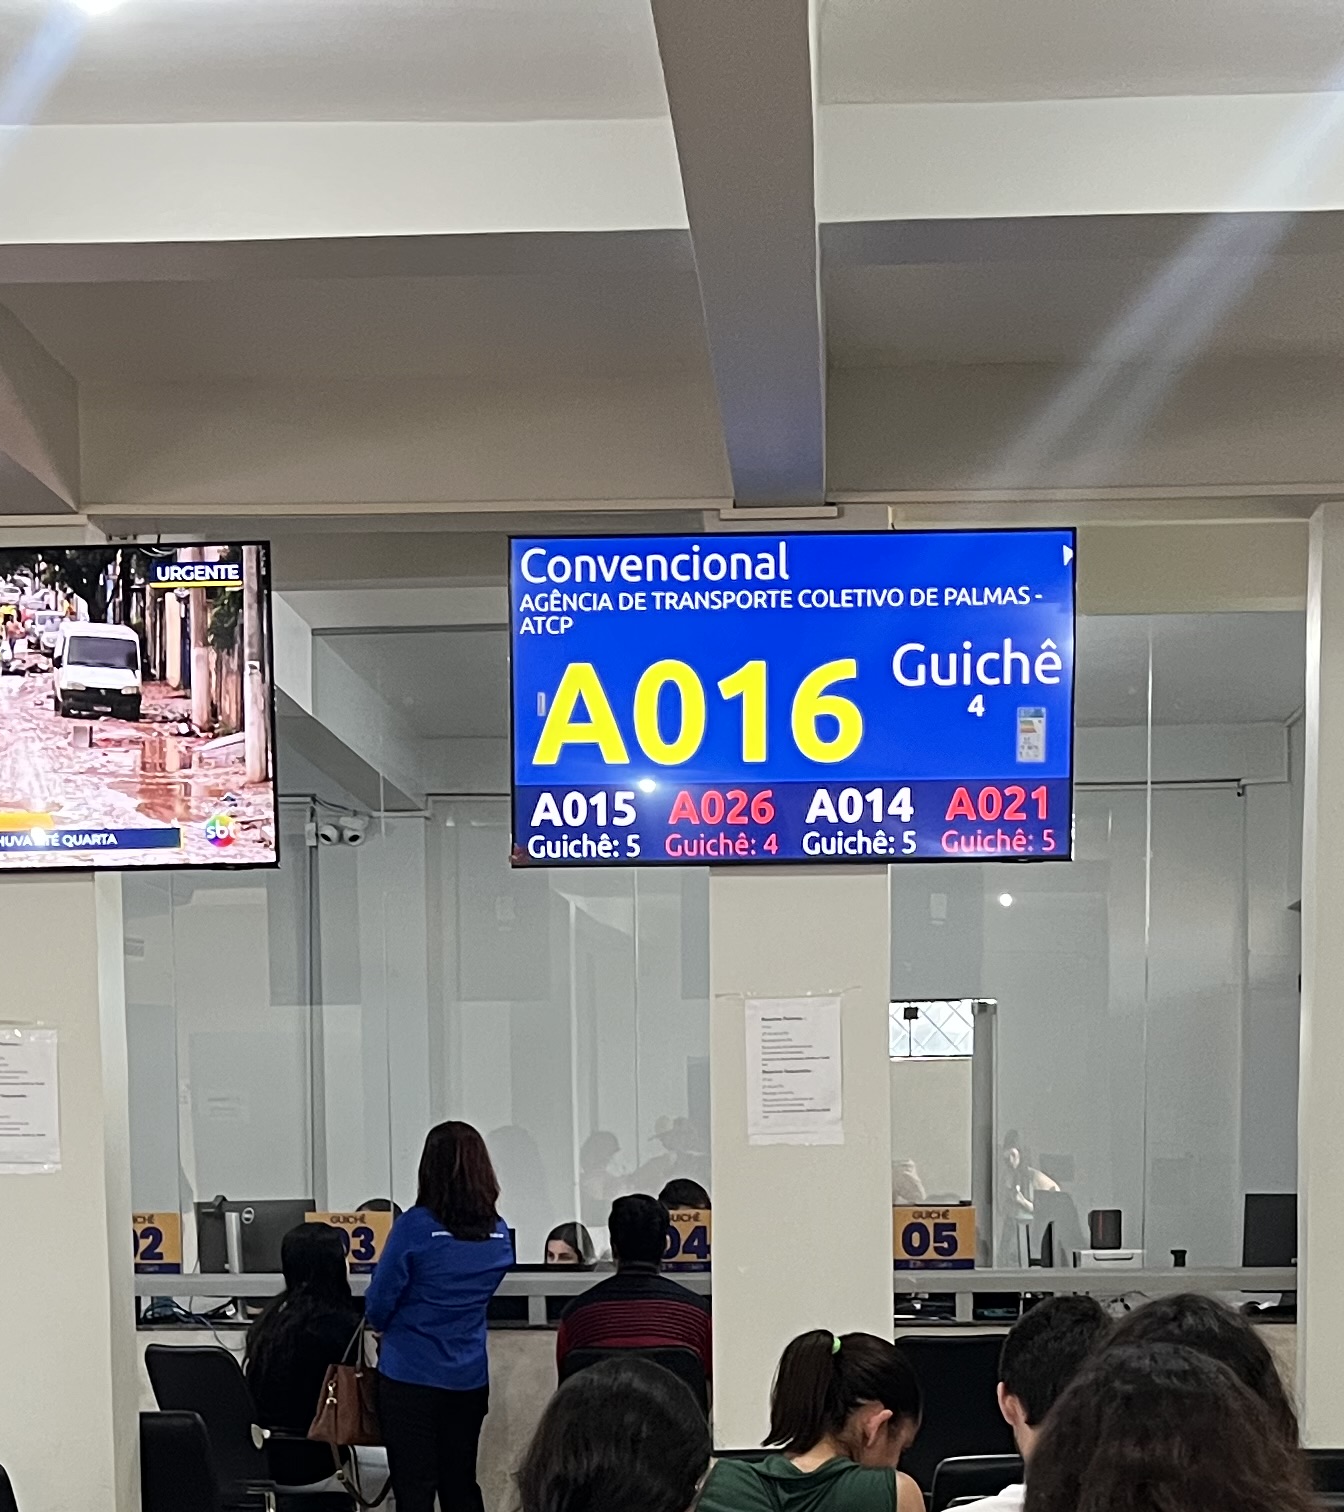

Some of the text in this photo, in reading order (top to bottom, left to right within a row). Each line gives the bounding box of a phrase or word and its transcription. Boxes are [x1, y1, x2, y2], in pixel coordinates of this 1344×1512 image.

[156, 564, 240, 581] URGENTE
[520, 541, 790, 584] Convencional
[519, 589, 614, 612] AGÊNCIA
[619, 592, 647, 611] DE
[651, 589, 793, 610] TRANSPORTE
[798, 588, 904, 609] COLETIVO
[910, 588, 938, 607] DE
[944, 586, 1031, 606] PALMAS
[519, 616, 574, 635] ATCP
[892, 638, 1062, 687] Guichê
[532, 657, 863, 766] A016
[967, 694, 985, 717] 4
[530, 790, 637, 827] A015
[668, 789, 775, 825] A026
[805, 786, 915, 824] A014
[945, 785, 1048, 821] A021
[62, 833, 118, 848] QUARTA
[206, 821, 237, 840] sbt
[802, 829, 917, 856] Guichê: 5
[941, 828, 1056, 853] Guichê: 5
[527, 833, 641, 859] Guichê: 5
[665, 832, 778, 857] Guichê: 4
[330, 1213, 367, 1225] GUICHÊ
[911, 1209, 950, 1220] GUICHÊ
[902, 1221, 959, 1257] 05
